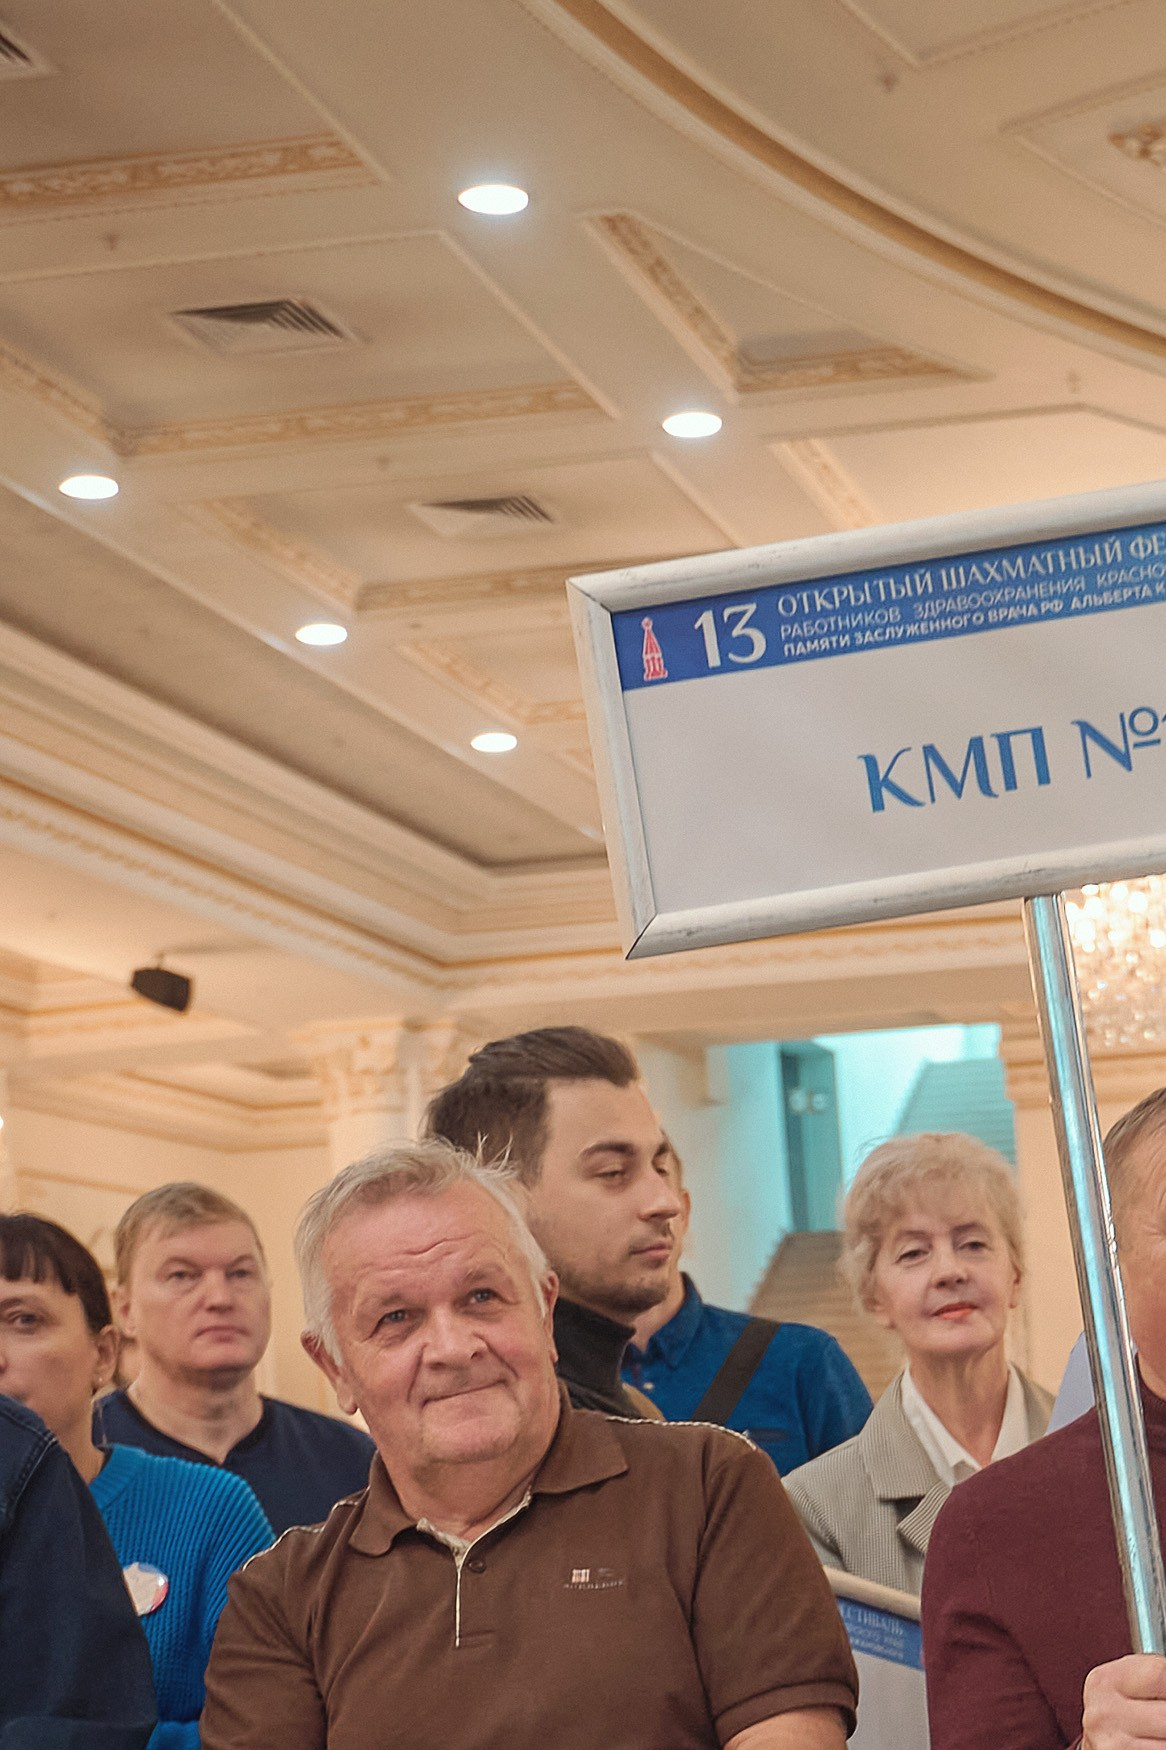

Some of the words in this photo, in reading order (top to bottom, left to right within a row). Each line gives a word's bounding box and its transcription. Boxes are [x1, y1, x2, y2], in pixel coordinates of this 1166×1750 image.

[778, 567, 933, 618] ОТКРЫТЫЙ
[940, 535, 1123, 592] ШАХМАТНЫЙ
[780, 606, 901, 641] РАБОТНИКОВ
[913, 575, 1086, 620] ЗДРАВООХРАНЕНИЯ
[693, 602, 767, 669] 13
[783, 633, 850, 657] ПАМЯТИ
[854, 611, 984, 646] ЗАСЛУЖЕННОГО
[988, 603, 1038, 624] ВРАЧА
[1041, 599, 1064, 614] РФ
[1070, 585, 1152, 610] АЛЬБЕРТА
[857, 726, 1051, 813] КМП
